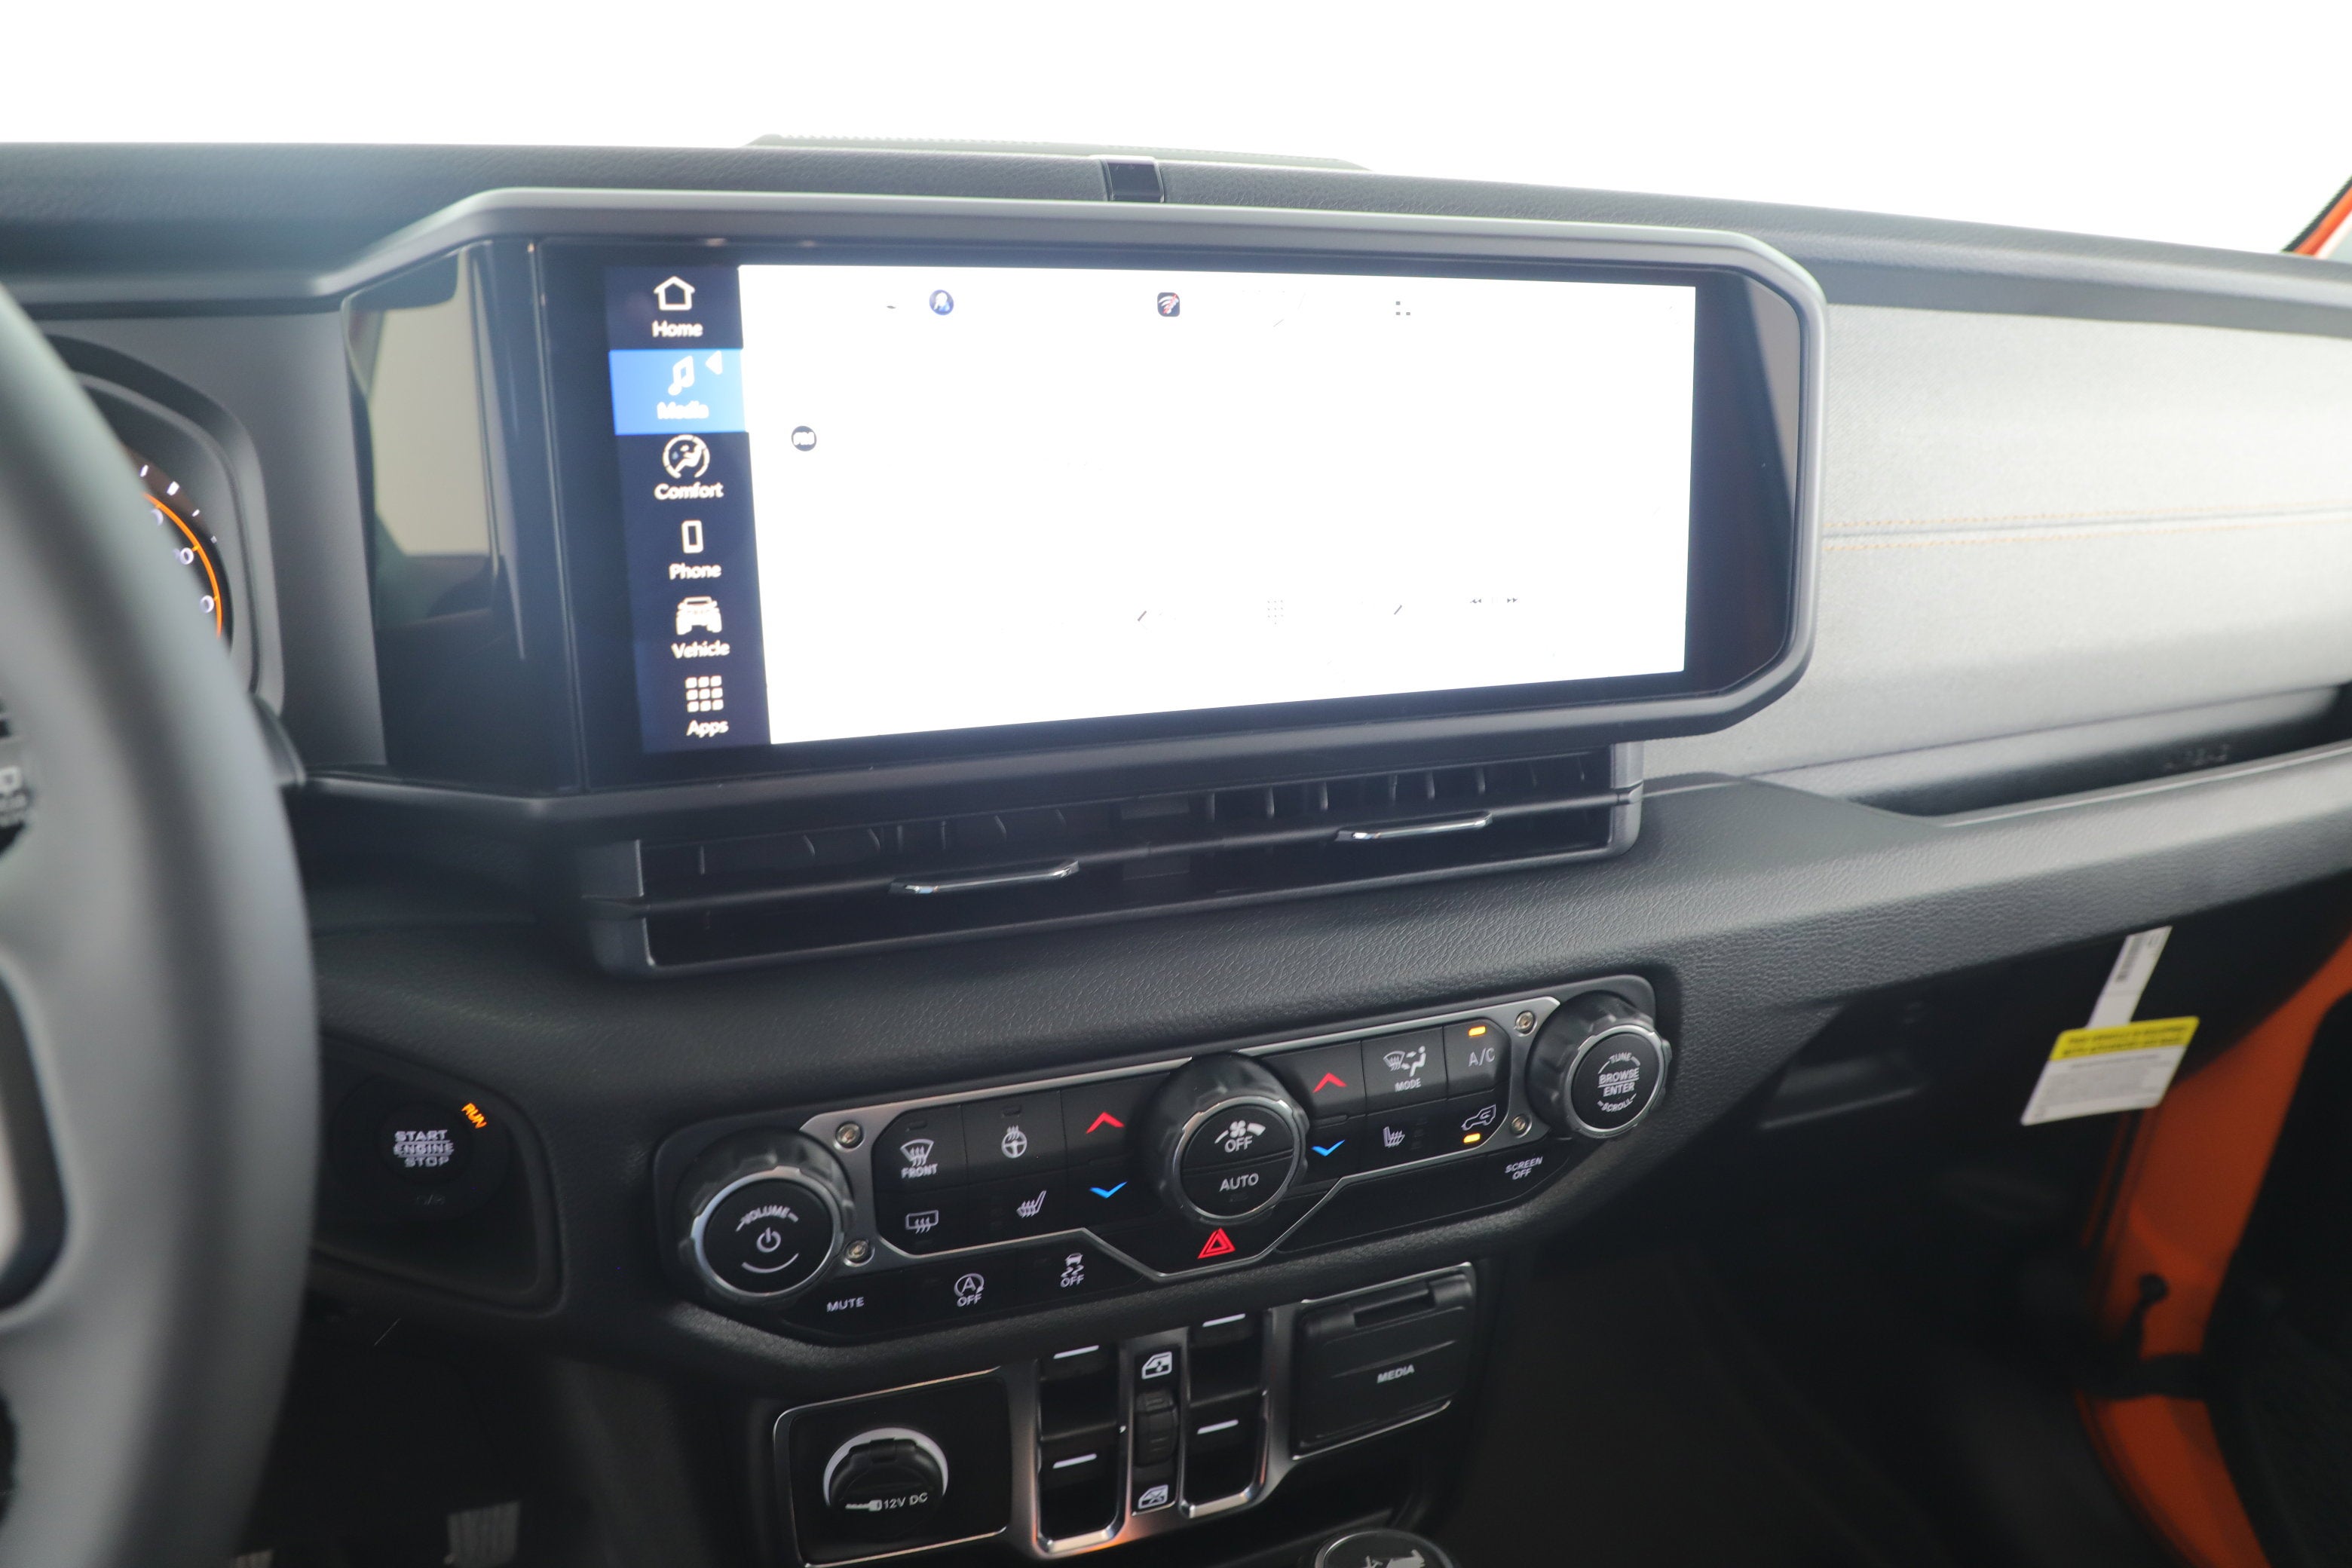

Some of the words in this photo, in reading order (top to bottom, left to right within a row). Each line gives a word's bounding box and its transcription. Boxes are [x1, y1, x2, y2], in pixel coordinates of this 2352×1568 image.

[652, 320, 703, 338] Home
[657, 401, 709, 420] Media
[654, 480, 724, 501] Comfort
[669, 562, 721, 580] Phone
[671, 639, 730, 660] Vehicle
[687, 719, 729, 738] Apps
[1468, 1046, 1496, 1067] A/C
[1609, 1052, 1632, 1064] TUNE
[1395, 1078, 1422, 1092] MODE
[1598, 1067, 1640, 1085] BROWSE
[1603, 1082, 1635, 1098] ENTER
[1601, 1098, 1633, 1113] SCROLL
[461, 1102, 488, 1129] RUN
[394, 1129, 448, 1142] START
[1223, 1135, 1253, 1153] OFF
[392, 1142, 455, 1156] ENGINE
[403, 1156, 450, 1168] STOP
[901, 1163, 938, 1179] FRONT
[1505, 1156, 1543, 1174] SCREEN
[1219, 1172, 1259, 1193] AUTO
[1511, 1168, 1532, 1181] OFF
[743, 1205, 791, 1225] VOLUME
[1060, 1274, 1085, 1288] OFF
[826, 1297, 865, 1312] MUTE
[957, 1293, 982, 1308] OFF
[1377, 1364, 1415, 1383] MEDIA
[884, 1496, 906, 1510] 12V
[909, 1492, 929, 1507] DC
